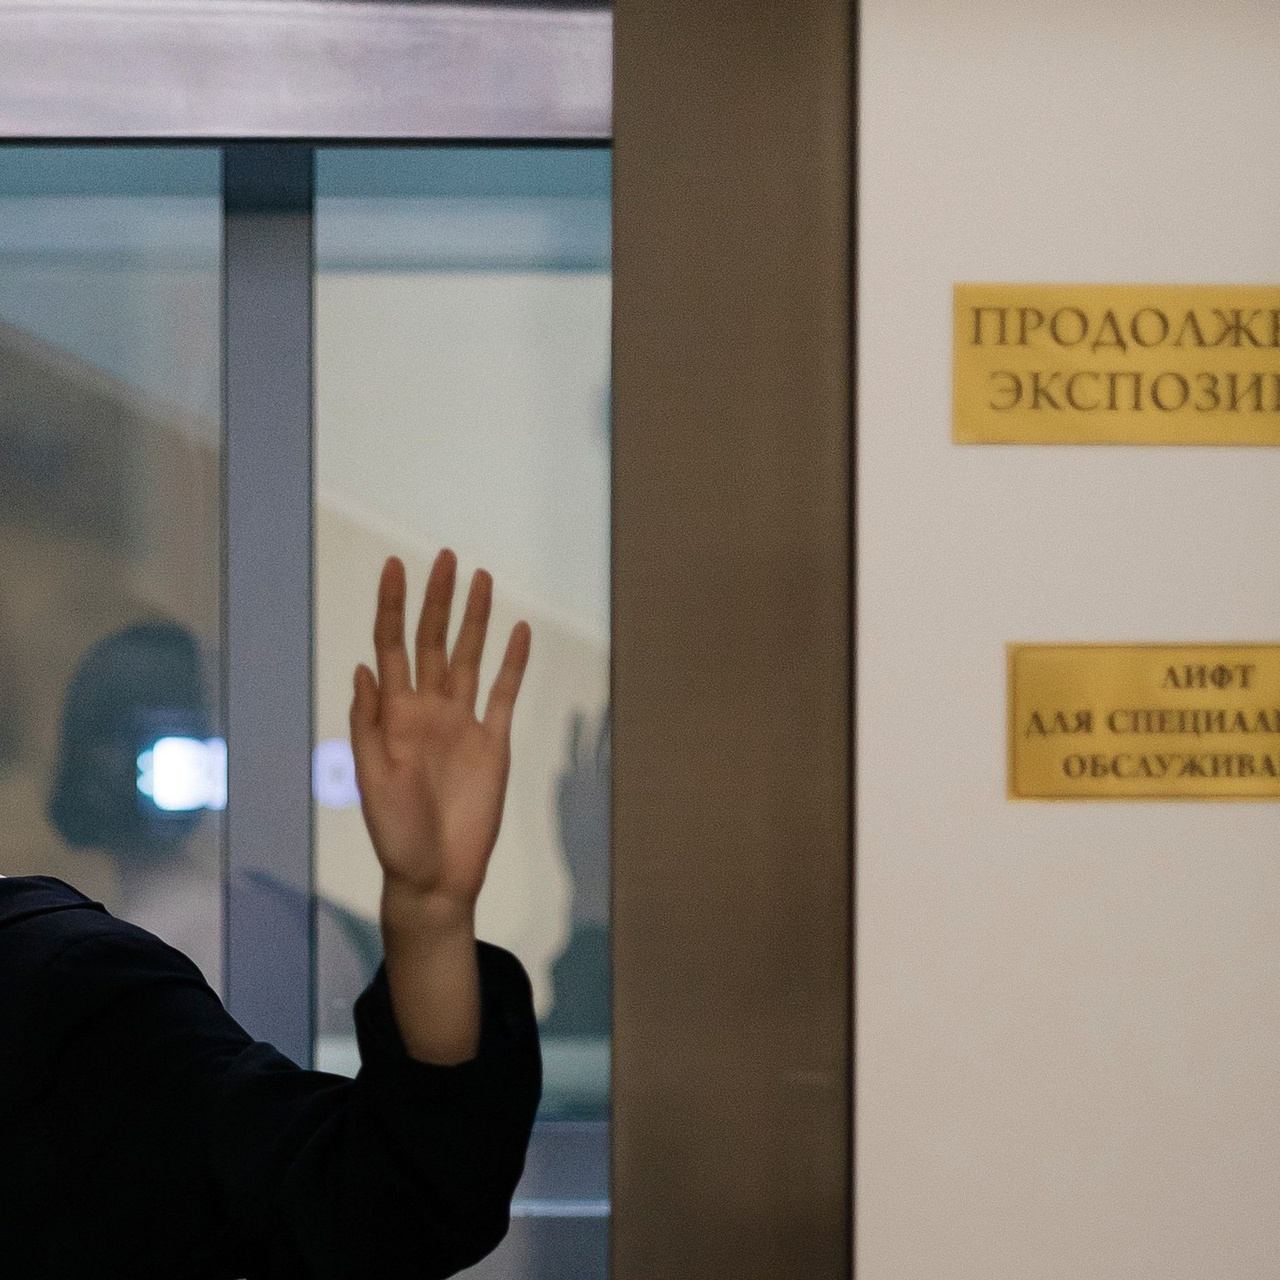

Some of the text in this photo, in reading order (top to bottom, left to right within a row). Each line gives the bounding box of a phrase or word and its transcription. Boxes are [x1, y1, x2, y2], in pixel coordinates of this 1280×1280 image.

[988, 371, 1280, 412] ЭКСПОЗИ
[1163, 663, 1255, 690] ЛИФТ
[1025, 708, 1280, 739] ДЛЯ СПЕЦИАЛ
